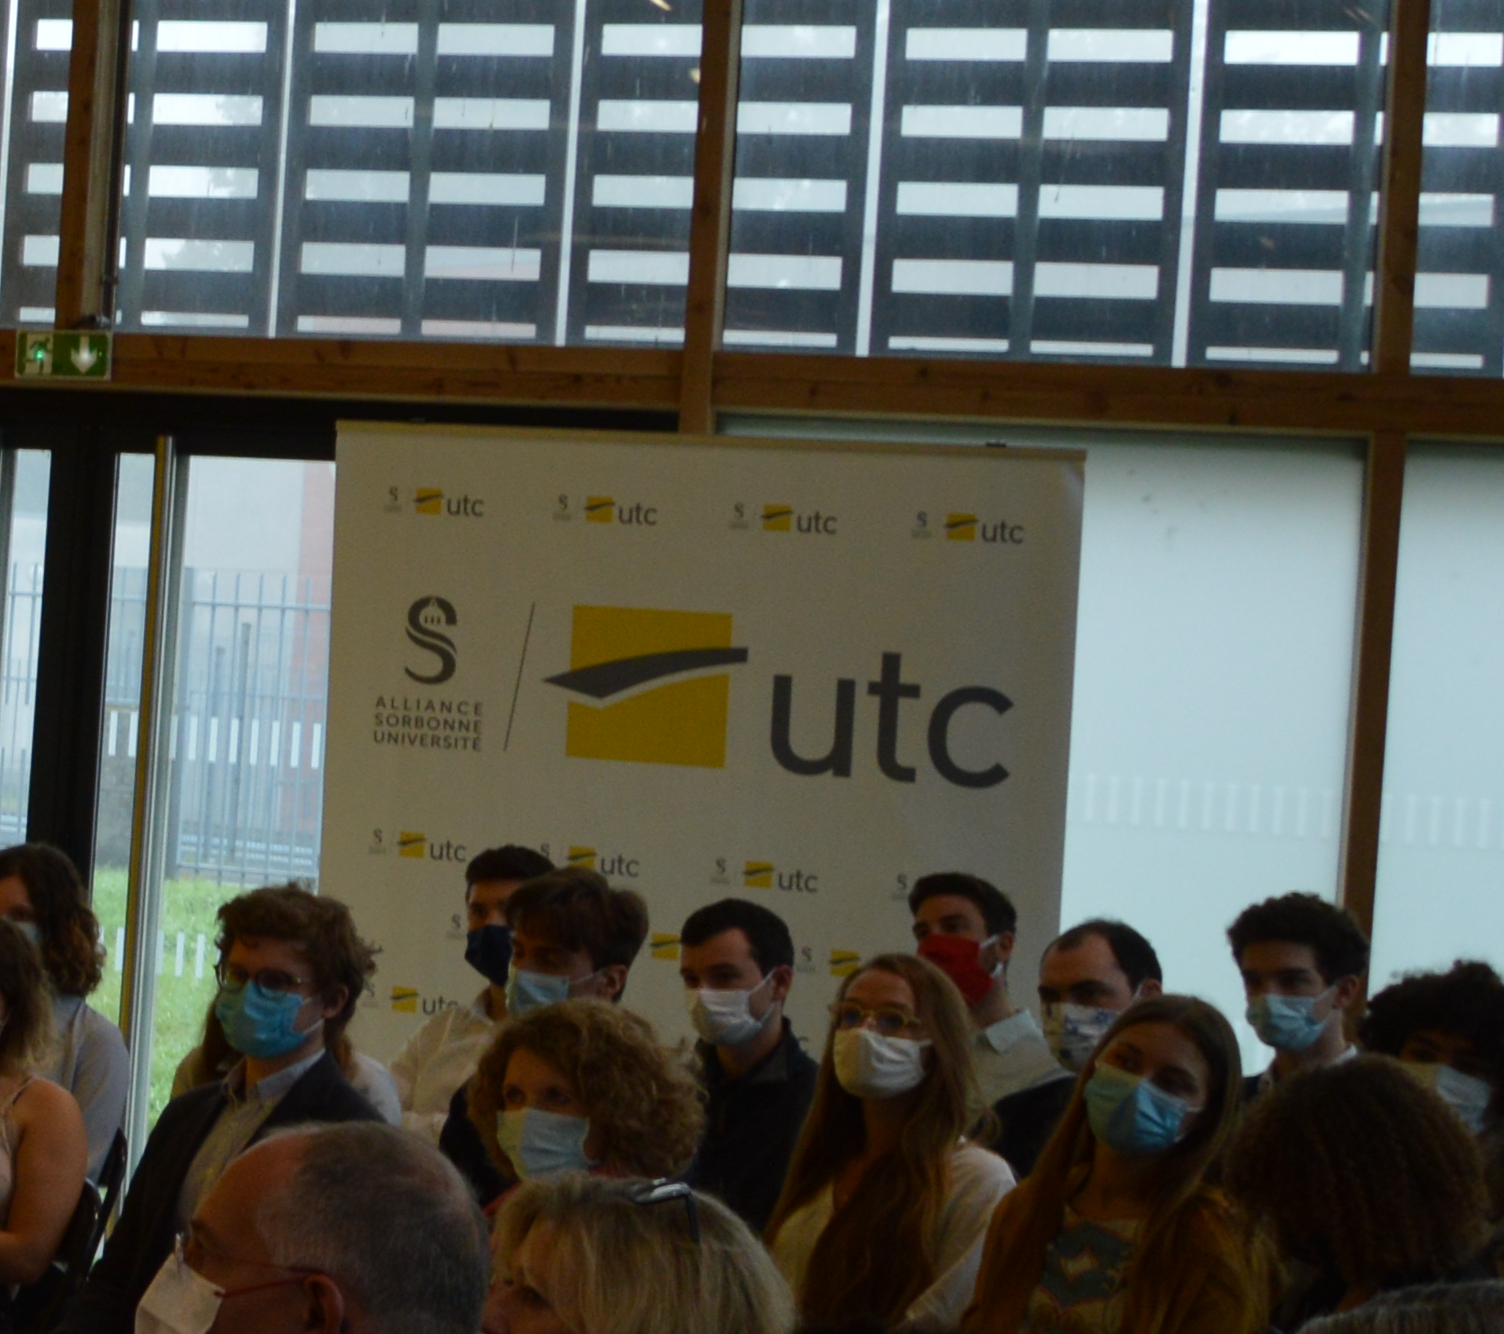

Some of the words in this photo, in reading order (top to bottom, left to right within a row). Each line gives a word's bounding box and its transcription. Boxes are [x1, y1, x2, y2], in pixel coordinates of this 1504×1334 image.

[447, 494, 484, 517] utc
[617, 502, 657, 526] utc
[796, 511, 837, 535] utc
[981, 520, 1024, 544] utc
[375, 695, 483, 716] ALLIANCE
[374, 713, 482, 735] SORBONNE
[769, 651, 1015, 790] utc
[429, 840, 466, 862] utc
[600, 855, 639, 878] utc
[778, 869, 818, 893] utc
